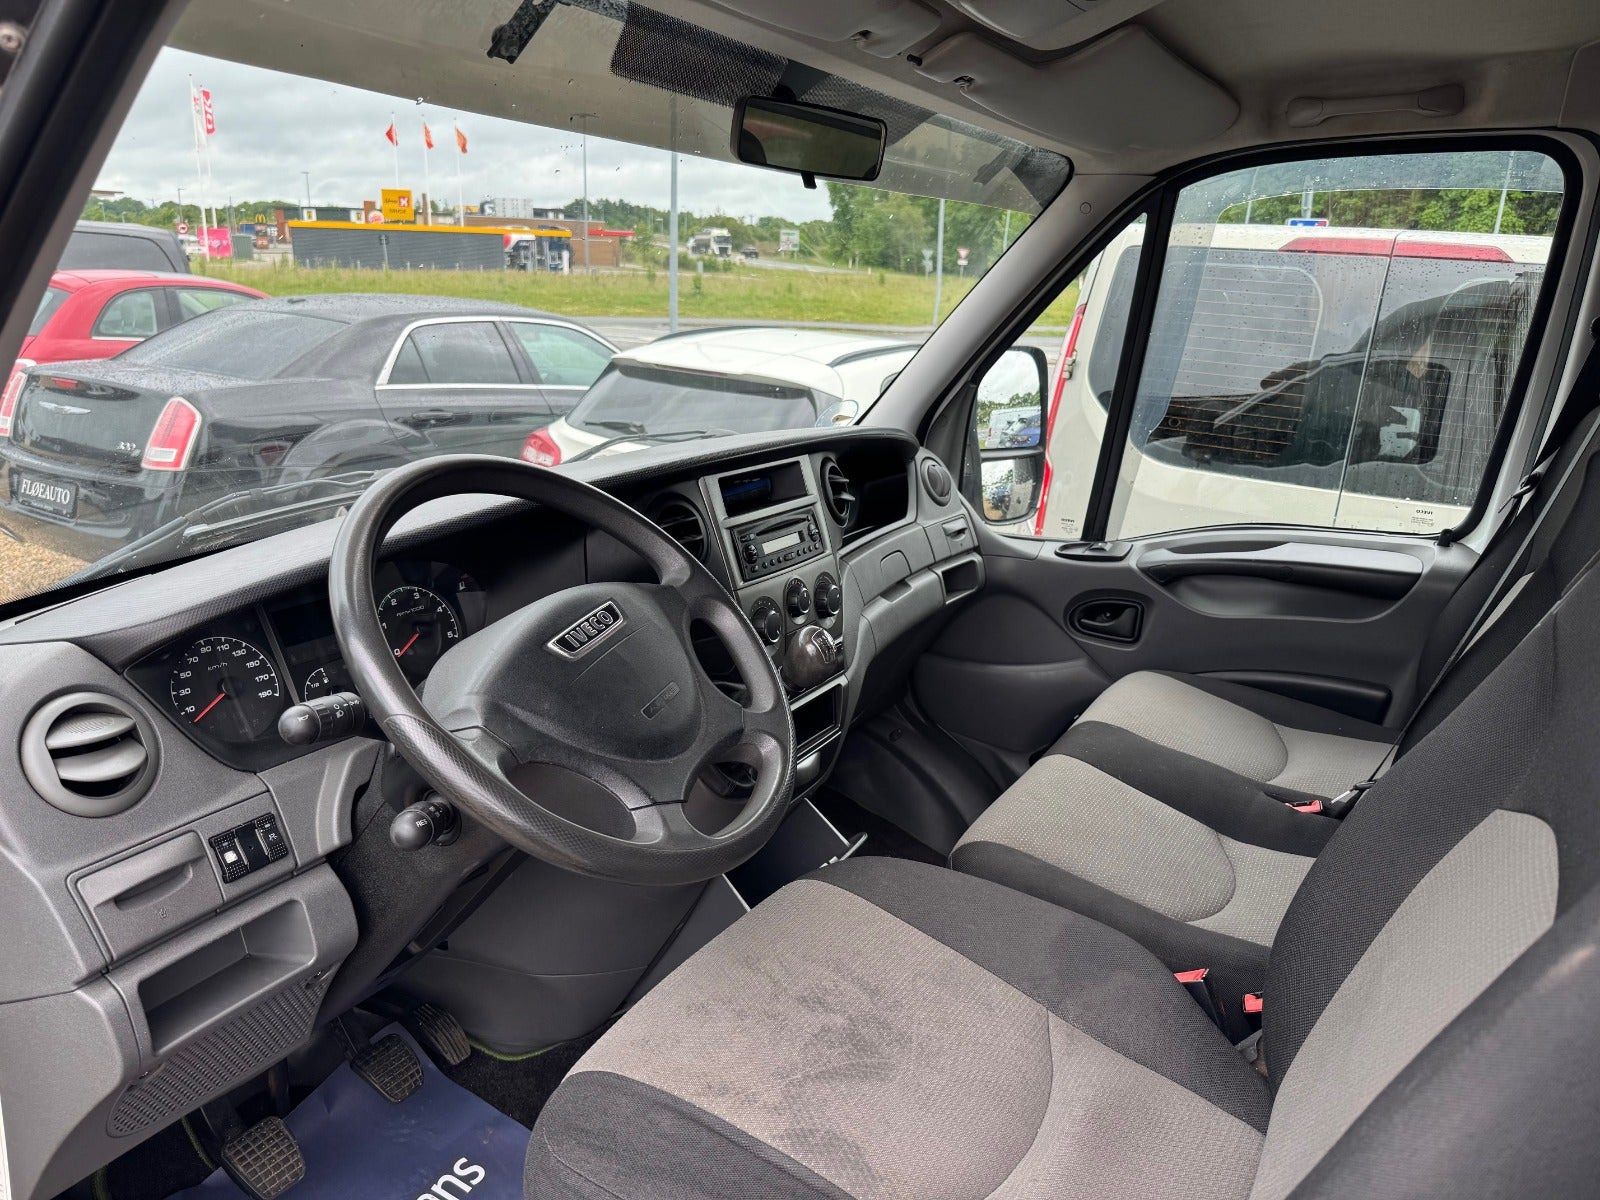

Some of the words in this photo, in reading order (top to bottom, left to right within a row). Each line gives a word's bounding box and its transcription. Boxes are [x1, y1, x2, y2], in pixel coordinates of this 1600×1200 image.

[390, 598, 398, 606] 2
[564, 610, 614, 648] IVECO
[200, 645, 212, 654] 90
[216, 643, 230, 652] 110
[231, 648, 247, 657] 130
[187, 656, 199, 665] 70
[245, 660, 260, 669] 150
[179, 670, 192, 679] 50
[255, 673, 270, 683] 170
[179, 688, 191, 696] 30
[258, 689, 273, 698] 190
[185, 705, 195, 713] 10
